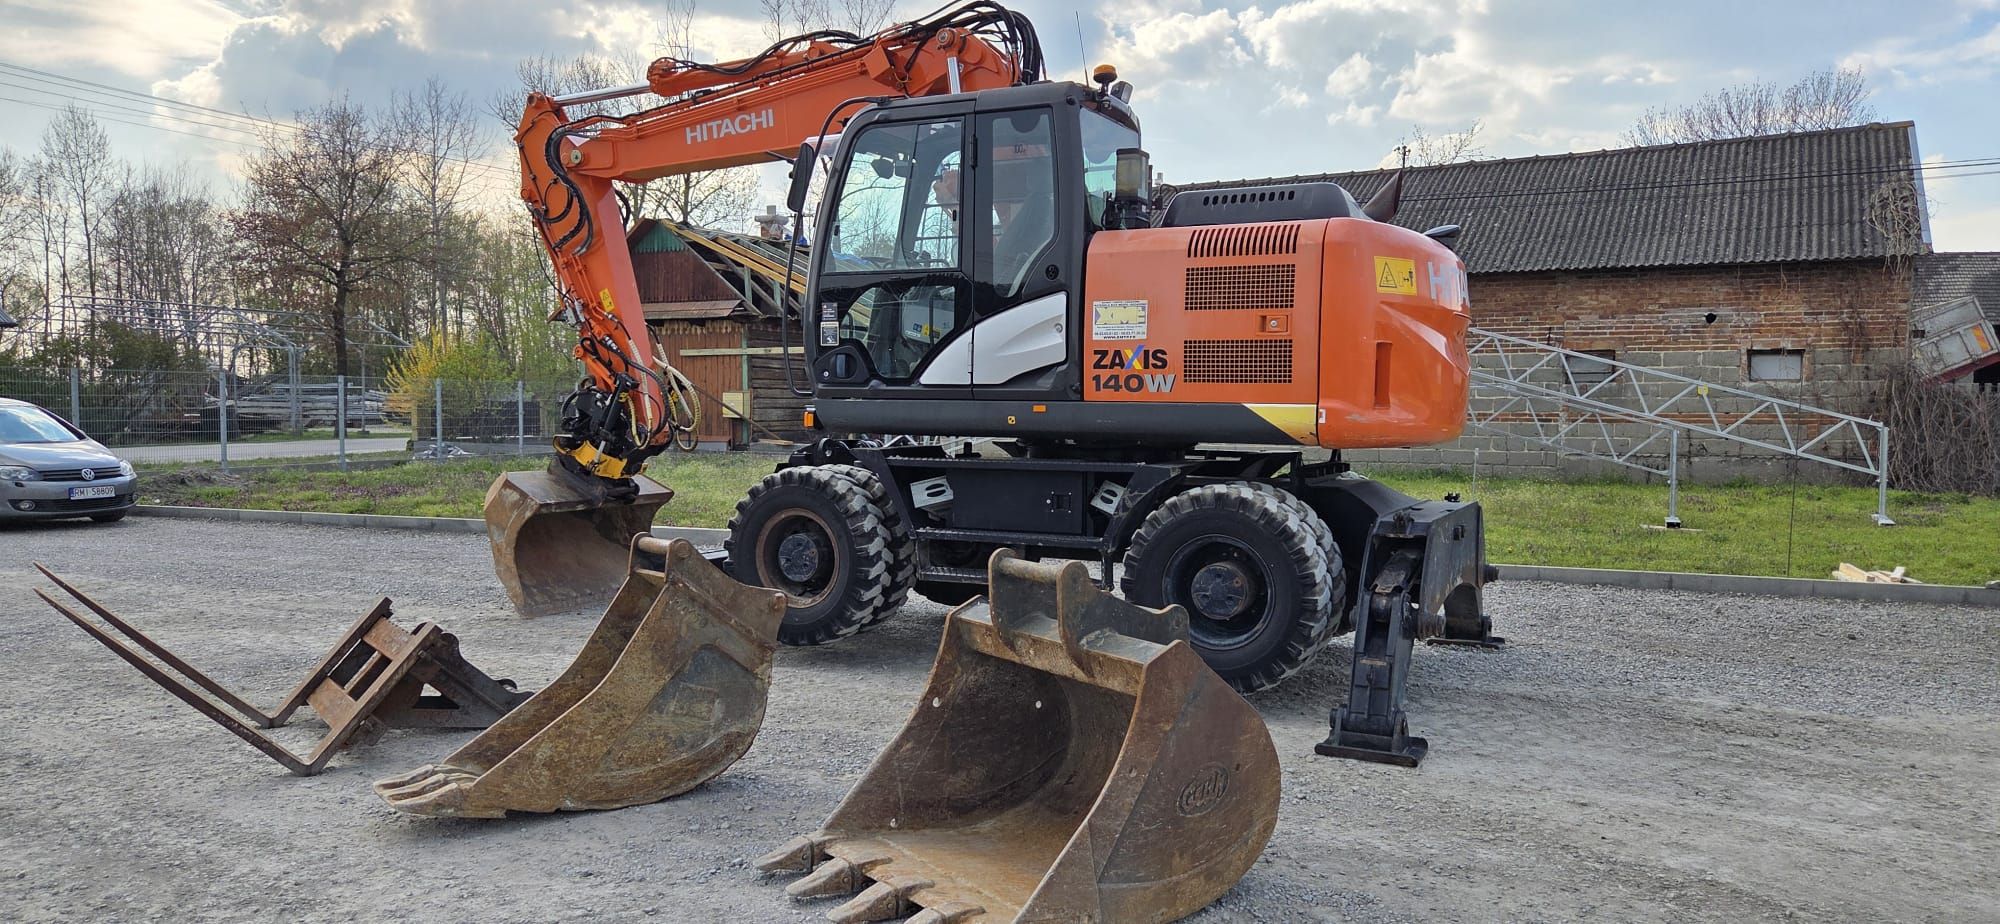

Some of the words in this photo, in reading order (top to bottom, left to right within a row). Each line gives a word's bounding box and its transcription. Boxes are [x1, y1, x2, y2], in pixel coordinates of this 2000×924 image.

[685, 109, 774, 145] HITACHI
[1093, 345, 1168, 370] ZAXIS
[1092, 374, 1176, 393] 140W
[74, 488, 89, 497] RMI
